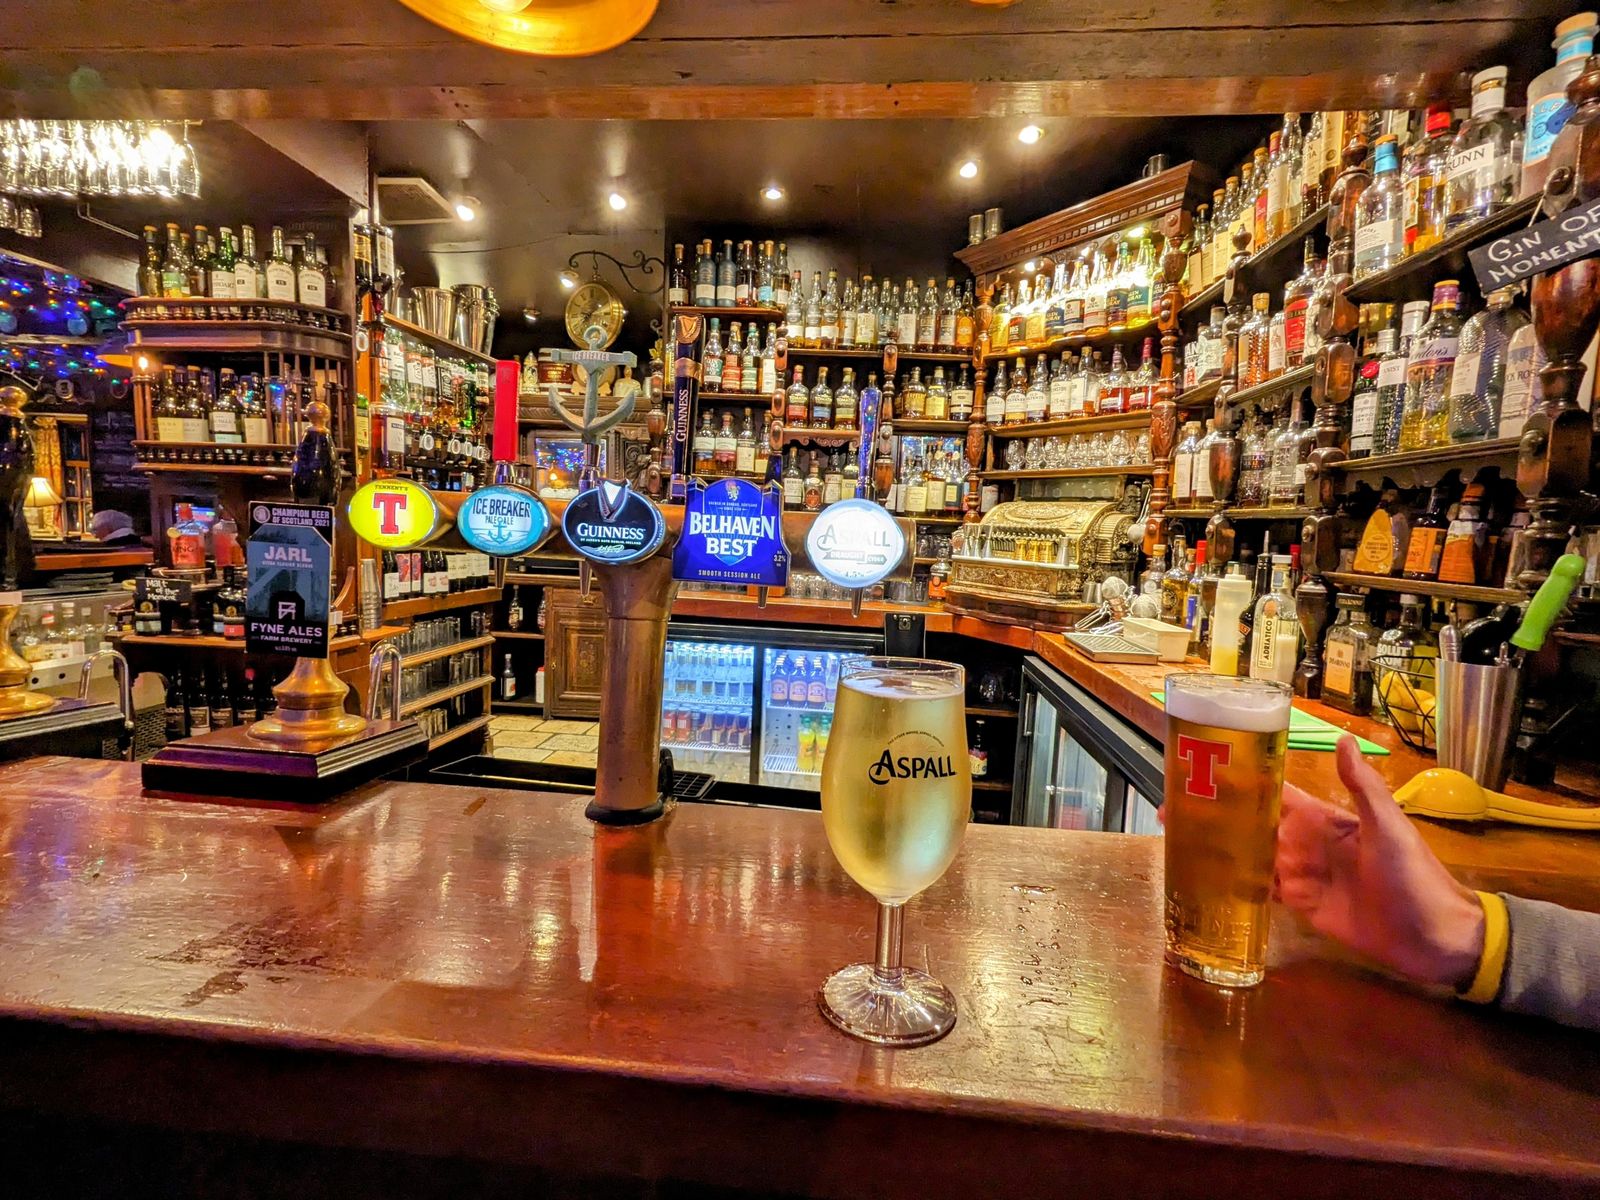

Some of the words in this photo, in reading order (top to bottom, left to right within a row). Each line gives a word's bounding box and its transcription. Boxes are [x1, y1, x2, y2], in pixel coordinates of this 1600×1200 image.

[1487, 230, 1542, 263] GIN
[675, 389, 688, 442] GUINNESS
[272, 507, 310, 518] CHAMPION
[311, 510, 330, 520] BEER
[373, 492, 407, 535] T
[472, 498, 488, 515] ICE
[489, 499, 530, 518] BREAKER
[272, 516, 281, 524] OF
[281, 517, 313, 526] SCOTLAND
[314, 518, 330, 527] 2021
[485, 515, 497, 524] PALE
[503, 516, 514, 526] ALE
[689, 511, 776, 540] BELHAVEN
[577, 522, 645, 540] GUINNESS
[816, 523, 891, 551] ASPALL
[264, 546, 313, 563] JARL
[706, 537, 757, 557] BEST
[146, 579, 169, 588] Malt
[698, 569, 722, 577] SMOOTH
[723, 571, 749, 579] SESSION
[251, 622, 285, 634] FYNE
[287, 625, 323, 637] ALES
[260, 634, 279, 642] FARM
[280, 636, 313, 644] BREWERY
[1263, 619, 1273, 661] ADRIATICO
[868, 748, 957, 786] ASPALL
[1178, 733, 1232, 800] T
